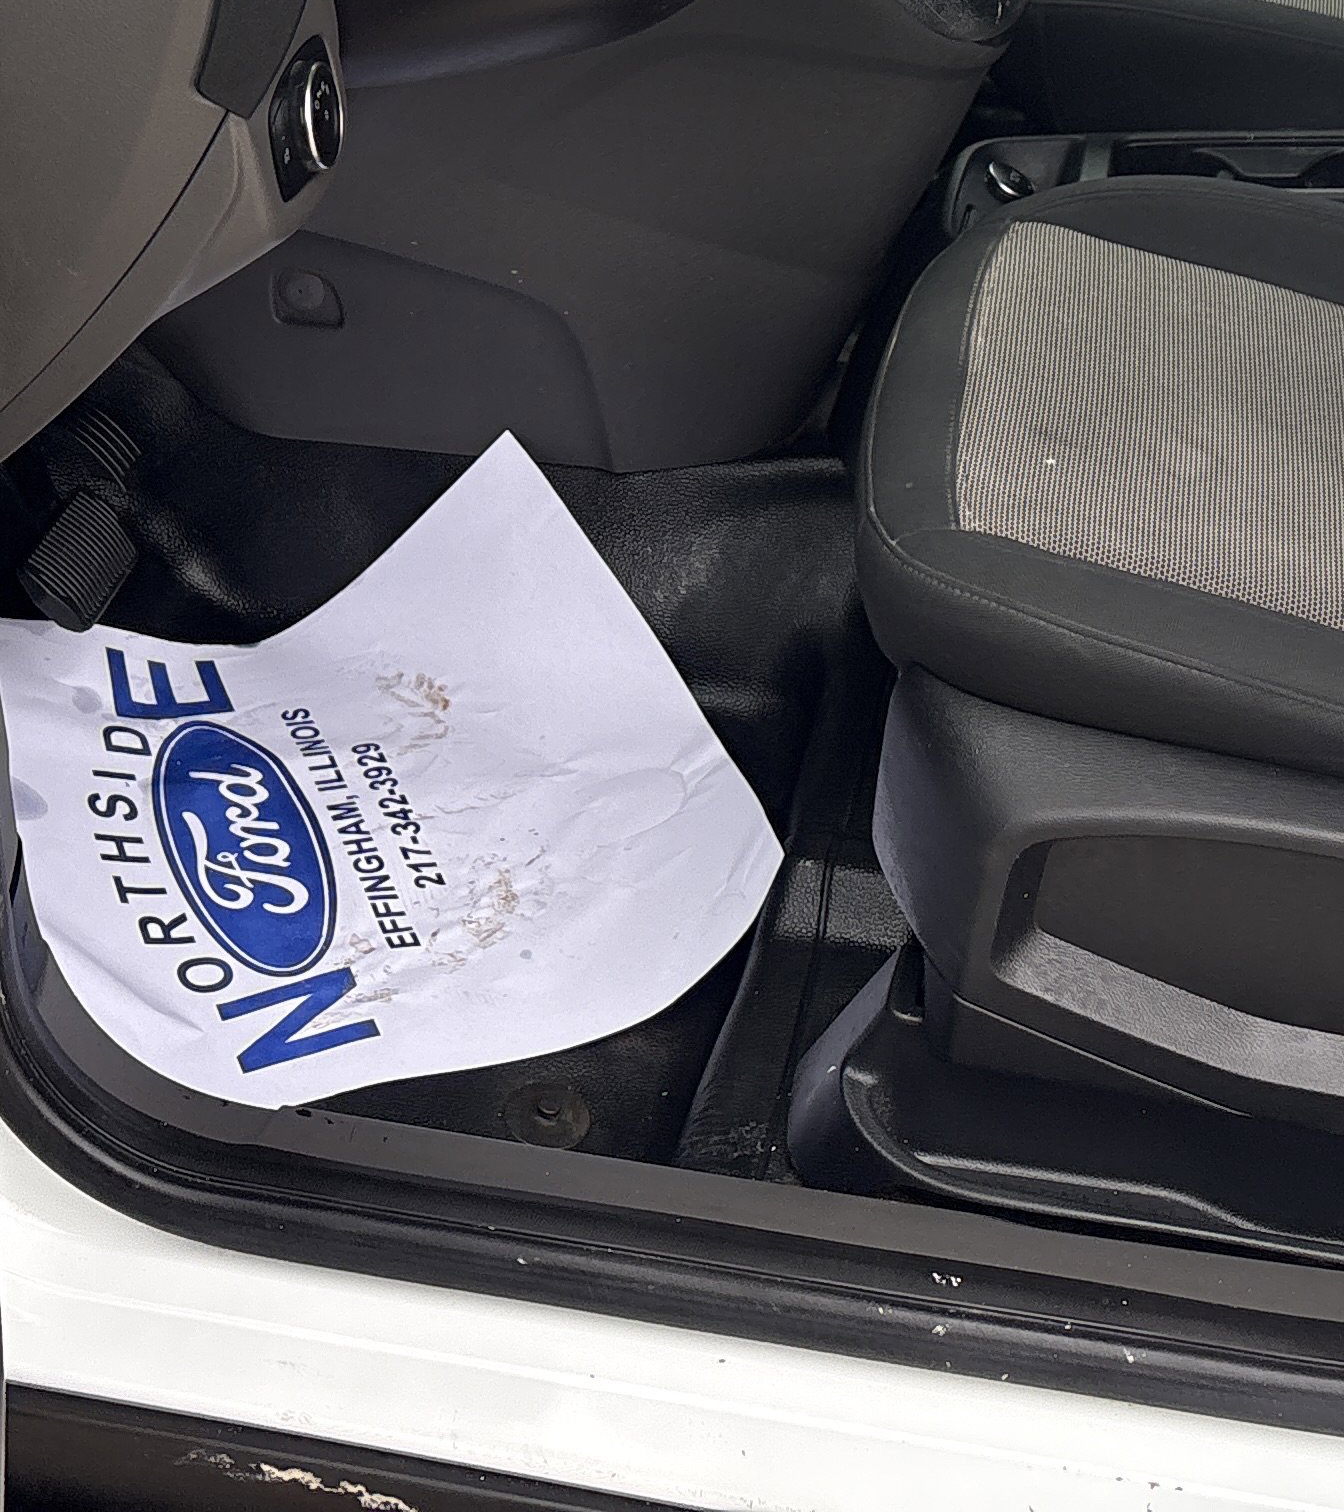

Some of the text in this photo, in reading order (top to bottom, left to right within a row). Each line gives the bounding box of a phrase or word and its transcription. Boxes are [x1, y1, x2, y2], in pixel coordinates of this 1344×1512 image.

[87, 647, 384, 1073] NORTHSIDE
[182, 762, 311, 915] Ford
[280, 707, 421, 950] EFFINGHAM, ILLINOIS
[351, 742, 447, 889] 217-342-3929
